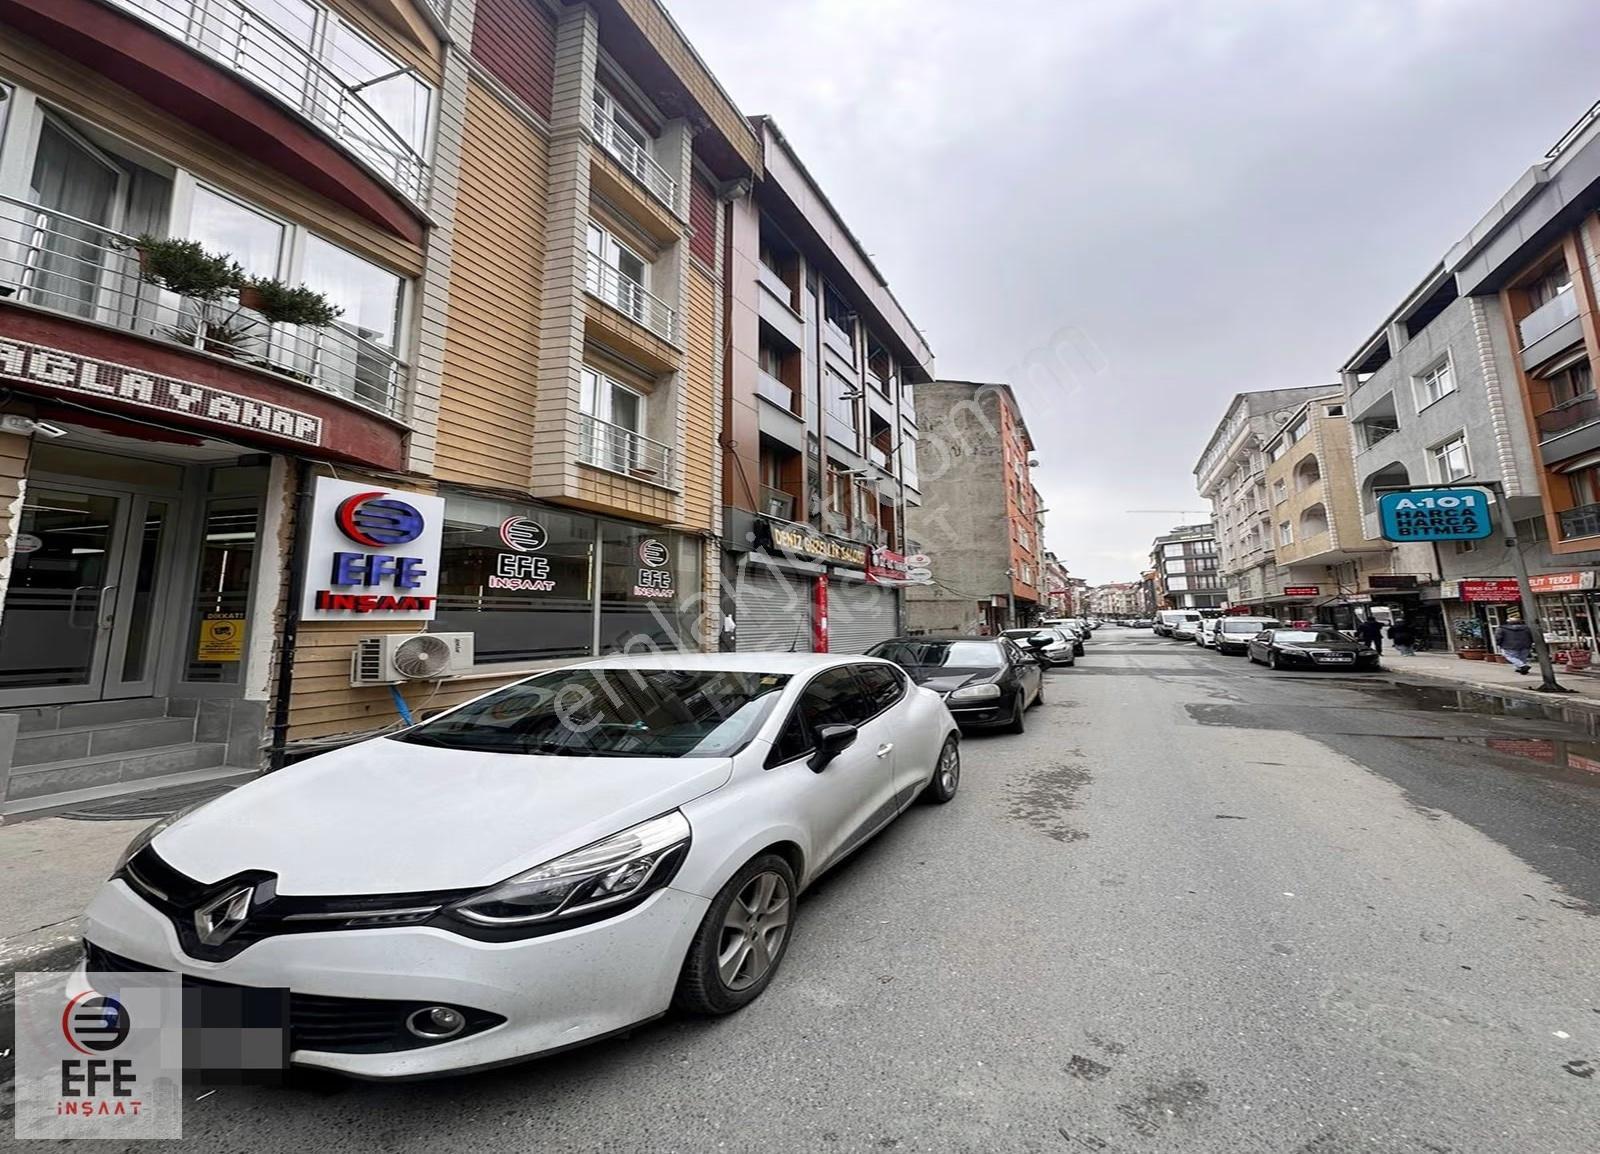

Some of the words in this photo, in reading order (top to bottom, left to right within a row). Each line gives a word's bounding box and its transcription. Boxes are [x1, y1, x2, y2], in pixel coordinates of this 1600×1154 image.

[1396, 508, 1476, 519] HARCA
[1397, 517, 1478, 527] HARCA
[331, 552, 427, 588] EFE
[497, 553, 550, 580] EFE
[488, 575, 556, 591] İNŞAAT
[638, 569, 672, 589] EFE
[315, 590, 437, 613] İNŞAAT
